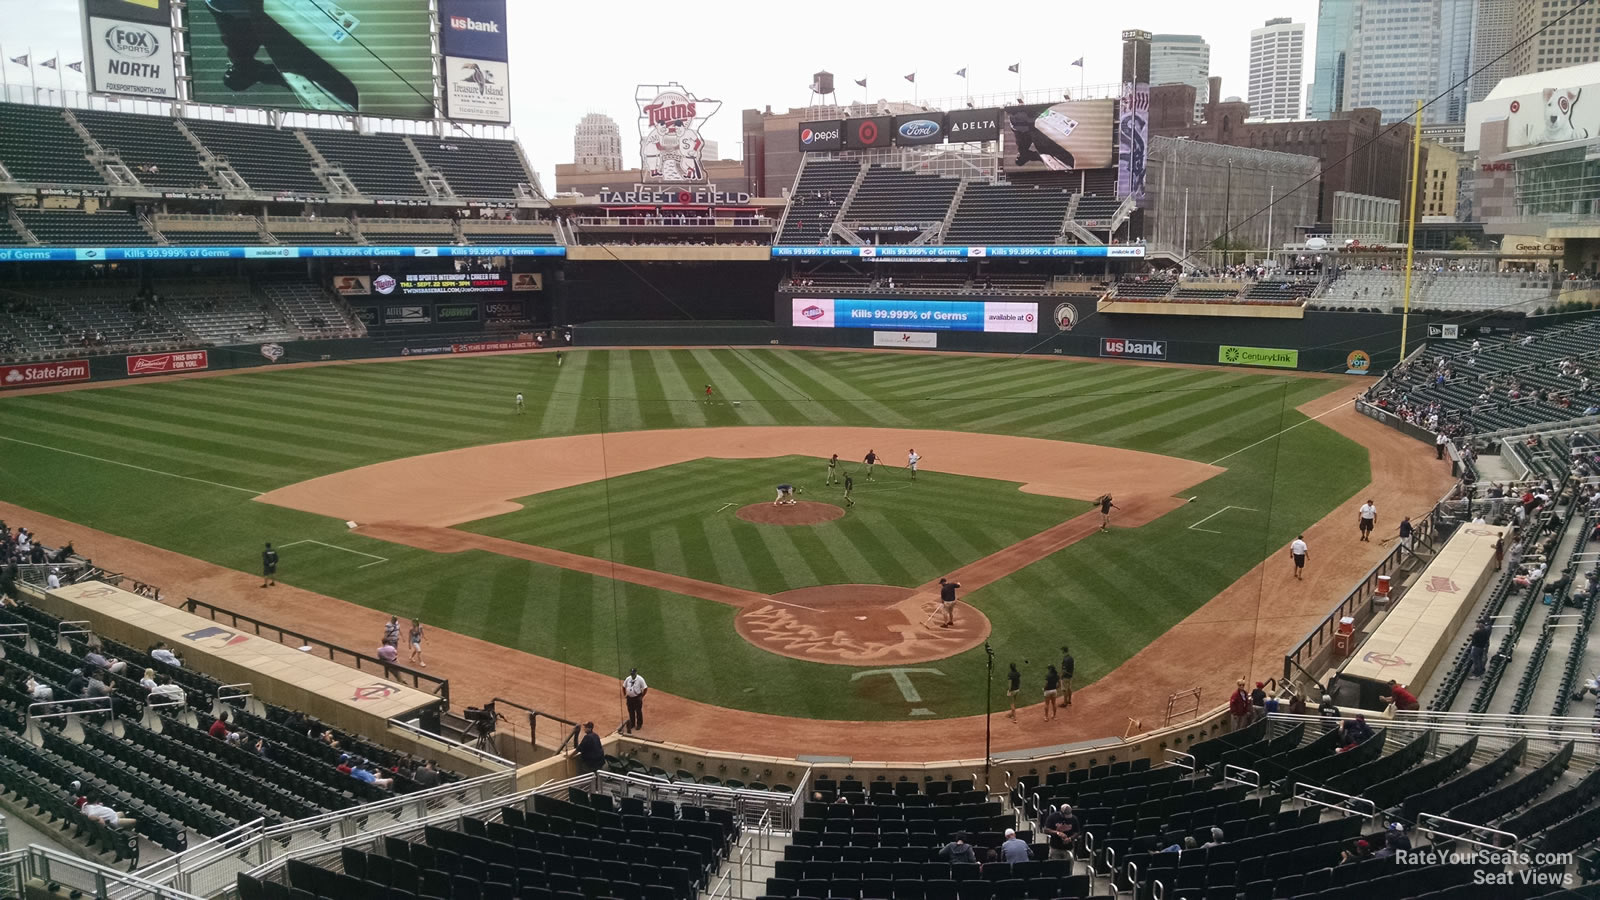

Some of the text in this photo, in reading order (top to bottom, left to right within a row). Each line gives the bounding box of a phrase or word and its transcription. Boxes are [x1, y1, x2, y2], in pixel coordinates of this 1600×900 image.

[451, 18, 499, 33] usbank
[116, 29, 148, 47] FOX
[117, 45, 149, 54] SPORTS
[108, 59, 160, 79] NORTH
[106, 82, 166, 95] FOXSPORTSNORTH.COM
[452, 82, 503, 97] Treasure Island
[643, 101, 696, 127] Twins
[906, 122, 931, 136] Ford
[962, 121, 996, 131] DELTA
[814, 129, 839, 143] pepsi
[682, 138, 691, 150] S
[600, 192, 751, 204] TARGET FIELD
[124, 249, 230, 258] Kills 99.999% of Germs
[312, 247, 329, 256] Kills
[364, 247, 372, 256] of
[374, 247, 401, 256] Germs
[451, 247, 468, 256] Kills
[502, 247, 510, 256] of
[511, 247, 535, 255] Germs
[1515, 243, 1564, 252] Great Clips
[0, 250, 51, 259] of Germs
[439, 306, 475, 318] SUBWAY
[851, 309, 967, 321] Kills 99.999% of Germs
[1106, 340, 1163, 355] usbank
[172, 354, 186, 362] THIS
[1241, 351, 1291, 363] CenturyLink
[172, 361, 184, 369] FOR
[25, 366, 84, 380] State Farm
[1337, 641, 1345, 649] G
